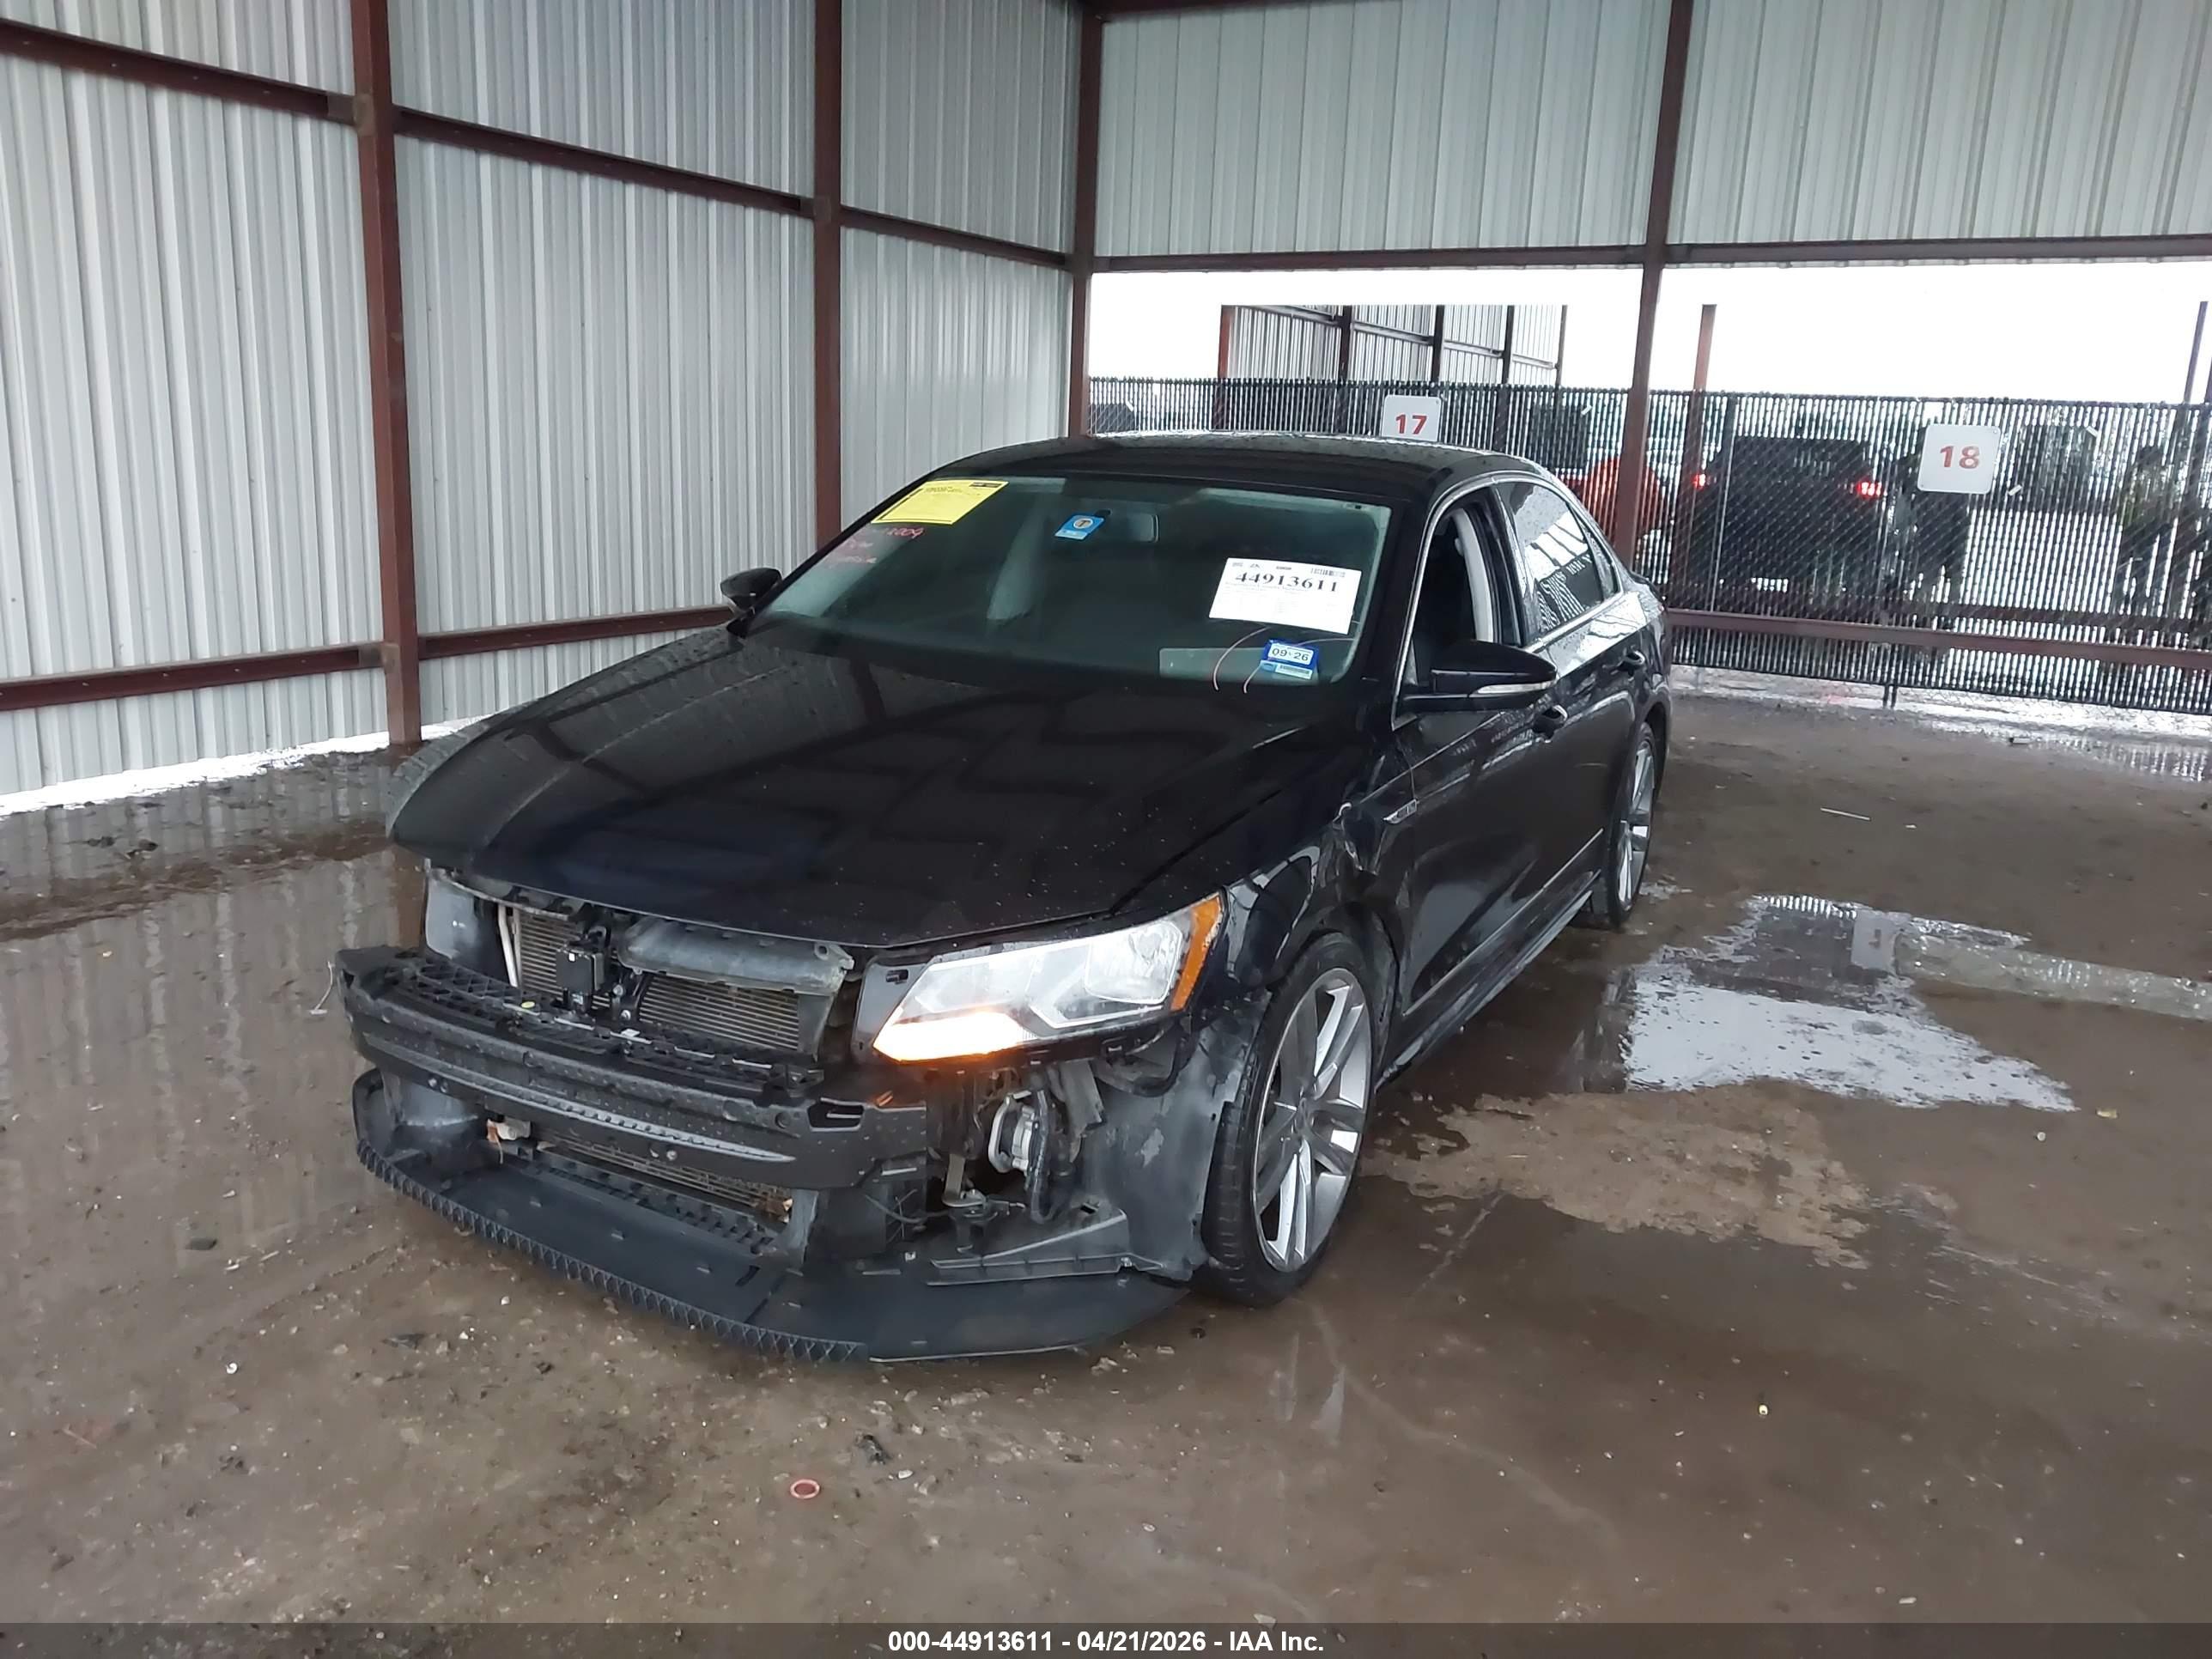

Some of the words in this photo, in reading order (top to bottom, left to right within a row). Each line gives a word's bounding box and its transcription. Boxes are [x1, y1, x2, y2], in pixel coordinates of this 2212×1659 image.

[1395, 414, 1427, 434] 17
[1940, 446, 1980, 469] 18
[1235, 572, 1337, 592] 44913611
